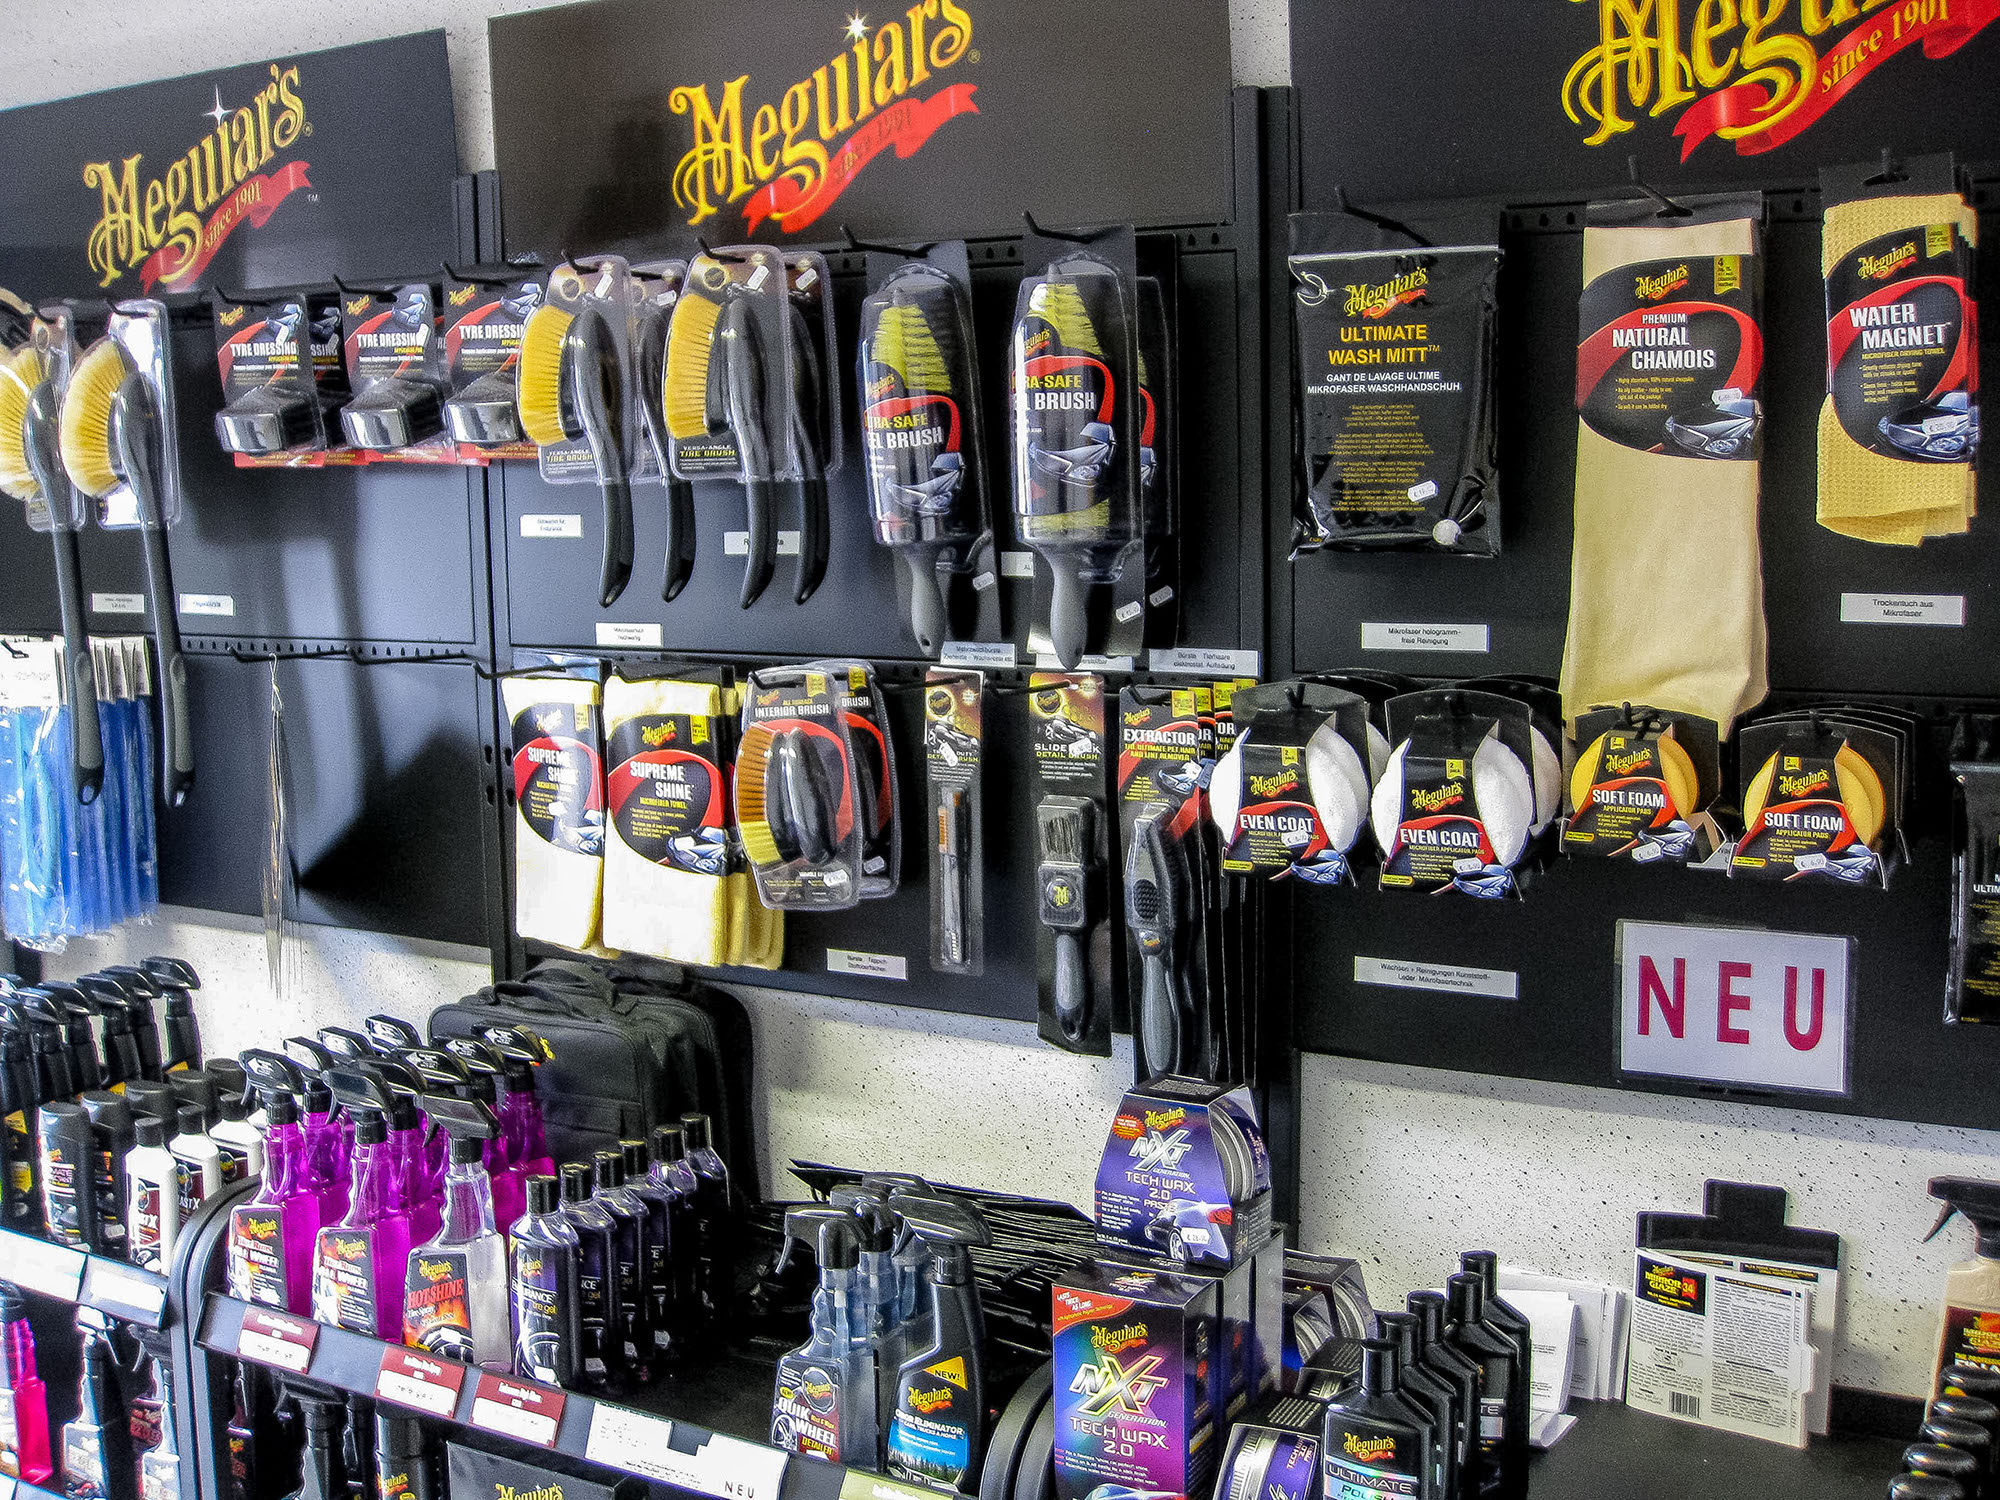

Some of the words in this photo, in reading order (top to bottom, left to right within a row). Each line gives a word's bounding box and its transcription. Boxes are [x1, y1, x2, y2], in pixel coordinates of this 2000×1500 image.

[1821, 27, 1883, 94] since
[668, 0, 972, 226] Meguiars
[83, 64, 304, 287] Meguiar's
[203, 210, 233, 251] since
[234, 181, 264, 216] 1901
[1858, 242, 1917, 279] Meguiar's
[1635, 264, 1689, 298] Meguiar's
[1344, 266, 1428, 317] Meguiar's
[1642, 313, 1686, 324] PREMIUM
[1850, 303, 1916, 327] WATER
[356, 333, 377, 347] TYRE
[459, 325, 478, 338] TYRE
[1340, 324, 1427, 342] ULTIMATE
[1612, 327, 1689, 348] NATURAL
[230, 343, 252, 357] TYRE
[253, 341, 297, 356] DRESSING
[1328, 349, 1381, 365] WASH
[1631, 349, 1715, 370] CHAMOIS
[1327, 374, 1352, 382] GANT
[1354, 373, 1366, 381] DE
[1368, 372, 1404, 381] LAVAGE
[1406, 371, 1439, 380] ULTIME
[1034, 392, 1096, 410] BRUSH
[886, 427, 942, 449] BRUSH
[1873, 599, 1918, 607] Trockentuch
[1883, 609, 1922, 617] Mikrofaser
[1417, 637, 1449, 645] Reinigung
[1422, 628, 1461, 636] hologramm-
[754, 706, 796, 718] INTERIOR
[798, 704, 829, 716] BRUSH
[841, 697, 869, 707] BRUSH
[1123, 728, 1196, 746] EXTRACTOR
[1034, 743, 1067, 751] SLIDE
[1135, 744, 1166, 752] ULTIMATE
[1606, 748, 1652, 773] Meguiar's
[630, 761, 685, 781] SUPREME
[656, 782, 692, 800] SHINE
[1250, 769, 1298, 797] Meguiar's
[1779, 769, 1829, 796] Meguiar's
[1412, 782, 1463, 811] Meguiar's
[1592, 790, 1625, 803] SOFT
[1628, 791, 1665, 808] FOAM
[1603, 806, 1636, 814] APPLICATOR
[1240, 815, 1275, 829] EVEN
[1277, 816, 1314, 832] COAT
[1765, 813, 1801, 828] SOFT
[1804, 815, 1843, 831] FOAM
[1400, 829, 1437, 845] EVEN
[1440, 831, 1479, 847] COAT
[1776, 829, 1811, 838] APPLICATOR
[1416, 966, 1455, 977] Reinigungen
[1637, 955, 1825, 1051] NEU
[1144, 1107, 1185, 1129] Meguiar's
[1129, 1129, 1192, 1171] NXT
[1125, 1171, 1158, 1188] TECH
[1161, 1178, 1196, 1194] WAX
[1150, 1188, 1171, 1201] 2.0
[1683, 1282, 1694, 1293] 34
[1091, 1322, 1148, 1352] Meguiar's
[935, 1370, 961, 1381] NEW!
[1069, 1354, 1169, 1416] NXT
[908, 1386, 953, 1410] Meguiar's
[778, 1397, 811, 1420] QUIK
[915, 1416, 964, 1435] ELIMINATOR
[1108, 1411, 1167, 1428] GENERATION
[796, 1418, 837, 1448] WHEEL
[1070, 1416, 1116, 1439] TECH
[1121, 1426, 1169, 1450] WAX
[1104, 1440, 1134, 1457] 2.0
[1344, 1432, 1396, 1459] Meguiar's
[1328, 1463, 1412, 1494] ULTIMATE
[725, 1480, 755, 1499] NEU
